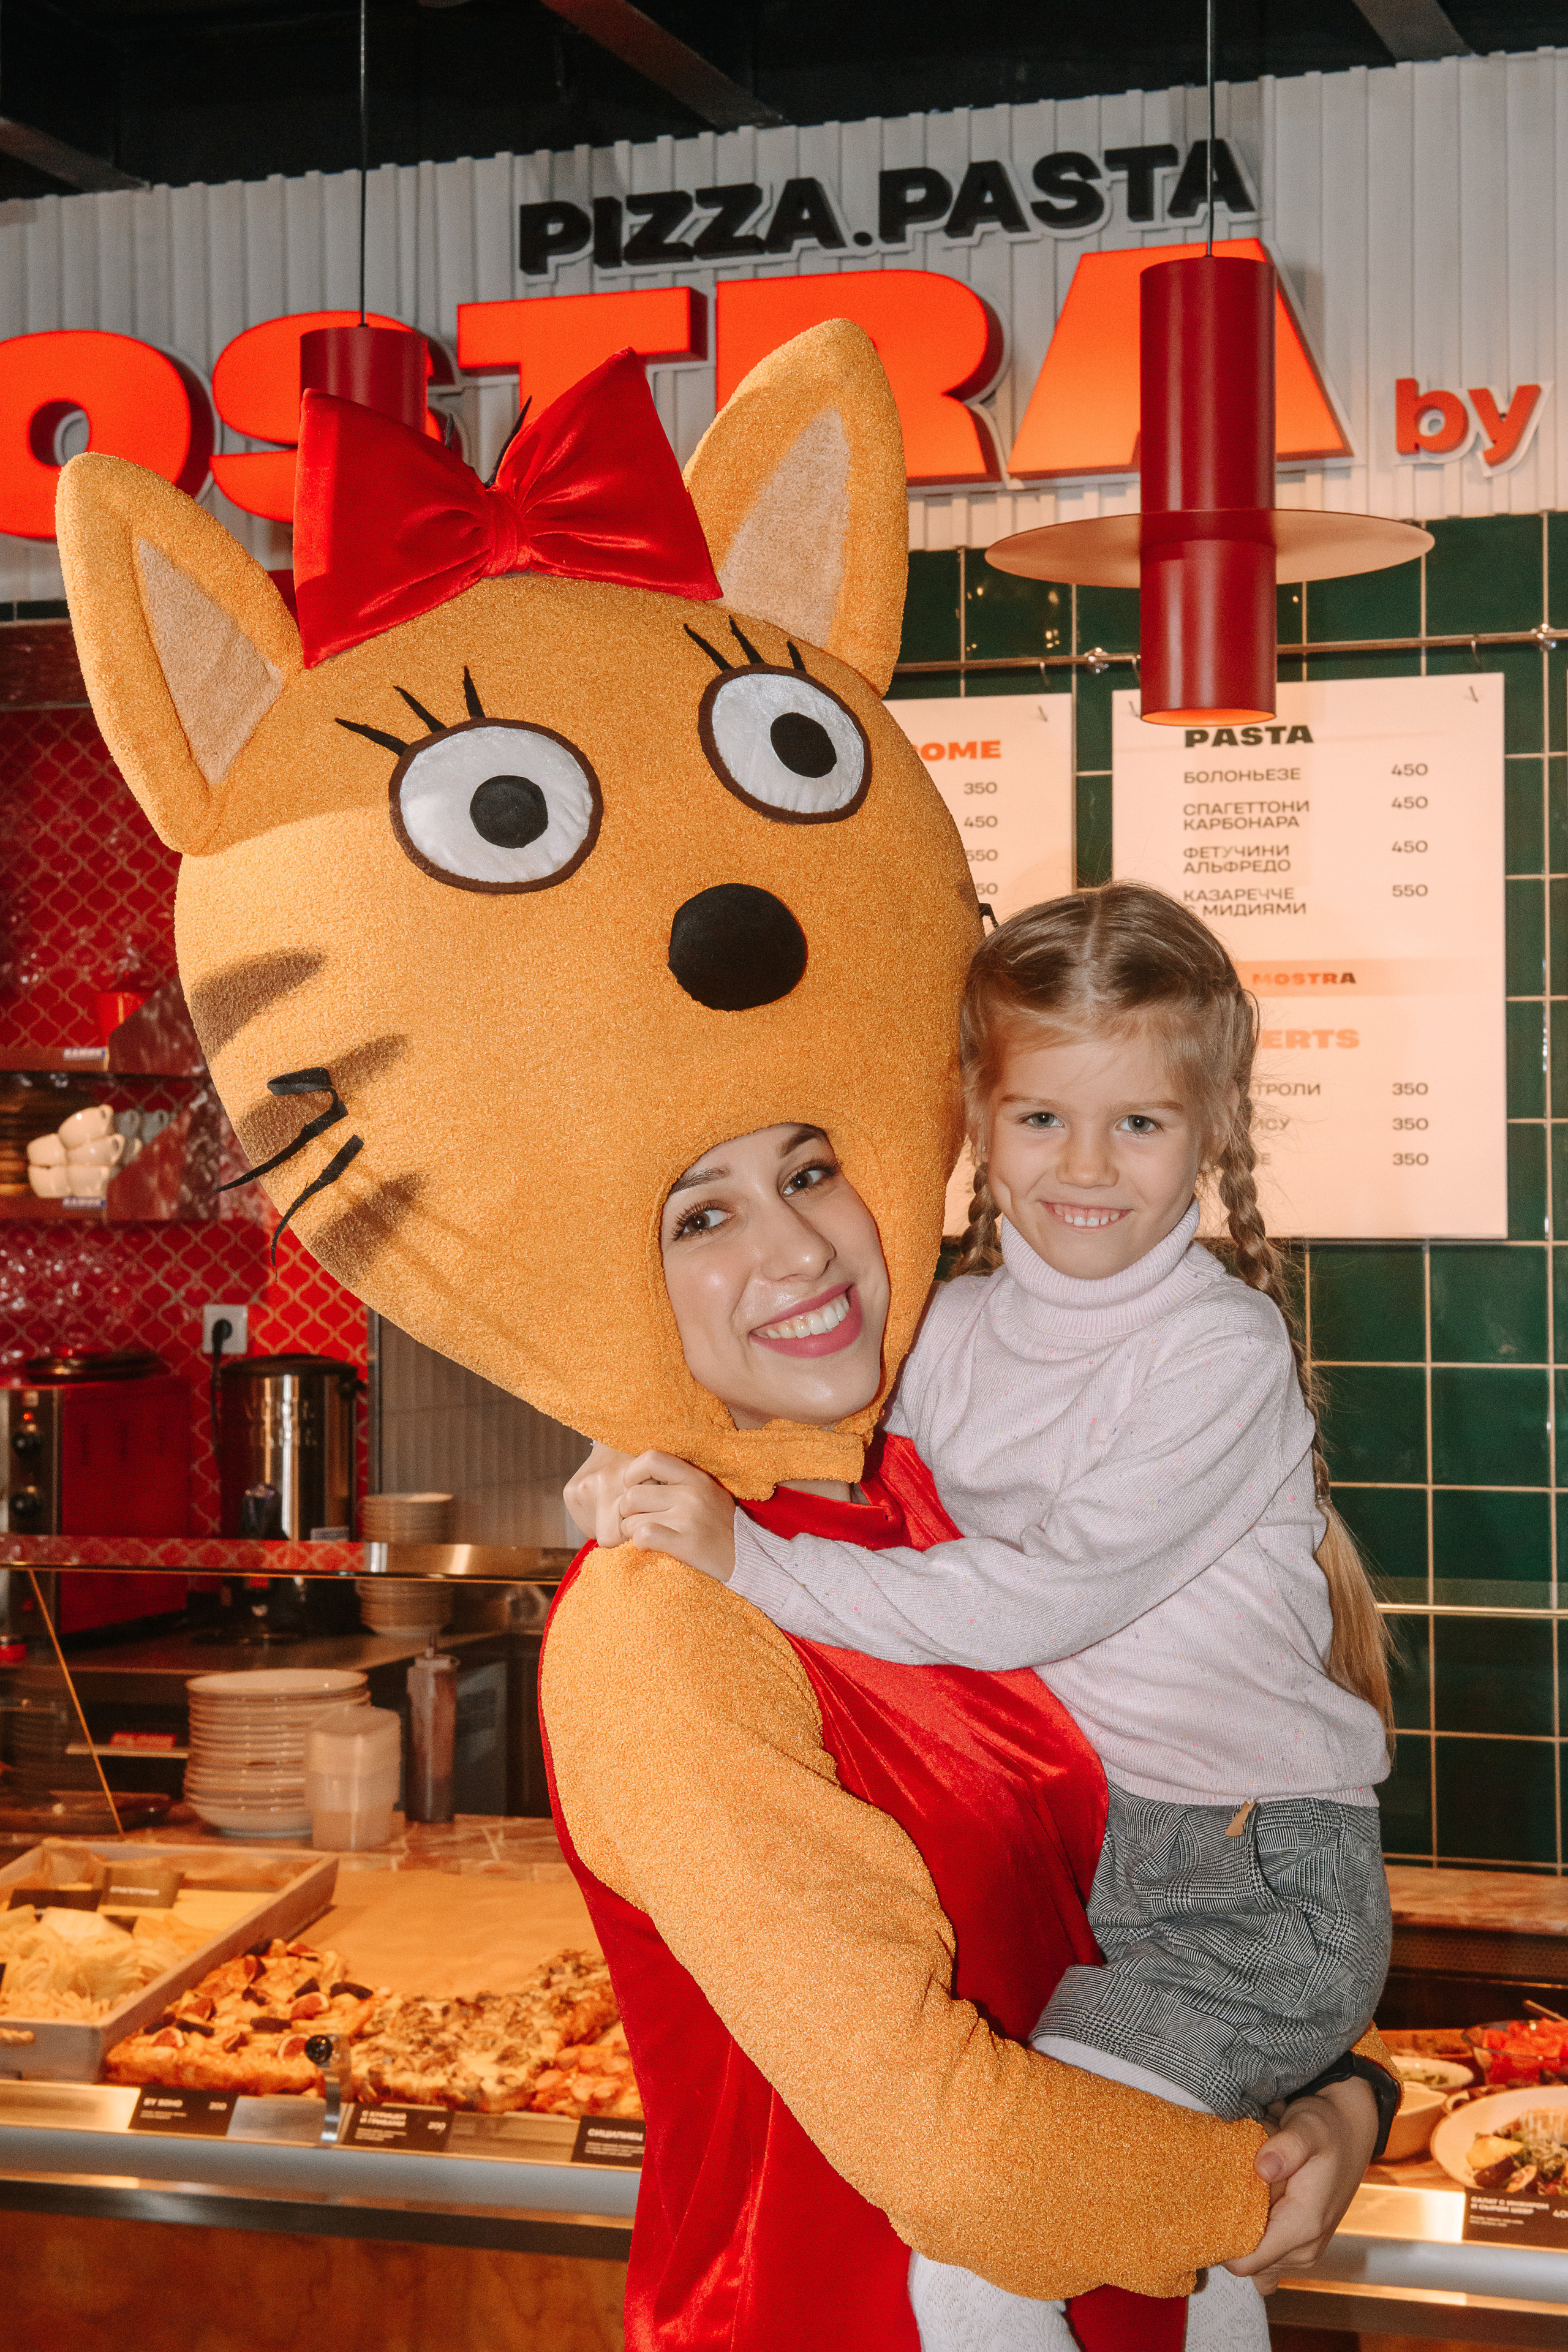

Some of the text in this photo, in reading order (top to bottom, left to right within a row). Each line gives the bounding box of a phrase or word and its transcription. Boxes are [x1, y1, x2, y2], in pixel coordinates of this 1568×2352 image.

[519, 138, 1256, 275] PIZZA.PASTA
[1396, 378, 1540, 466] by
[1185, 725, 1314, 748] PASTA
[913, 740, 1001, 761] OME
[1184, 763, 1428, 784] БОЛОНЬЕЗЕ 450
[963, 782, 998, 795] 350
[1183, 796, 1428, 816] СПАГЕТТОНИ 450
[964, 815, 998, 828] 450
[1183, 816, 1300, 831] КАРБОНАРА
[1183, 840, 1428, 859] ФЕТУЧИНИ 450
[1183, 859, 1291, 874] АЛЬФРЕДО
[976, 883, 998, 895] 50
[1183, 884, 1428, 902] КАЗАРЕЧЧЕ 550
[1203, 903, 1306, 917] МИДИЯМИ
[1252, 972, 1356, 986] MOSTRA
[1261, 1029, 1360, 1049] ERTS
[1256, 1083, 1429, 1096] ТРОЛИ 350
[1392, 1118, 1429, 1131] 350
[1392, 1153, 1429, 1166] 350
